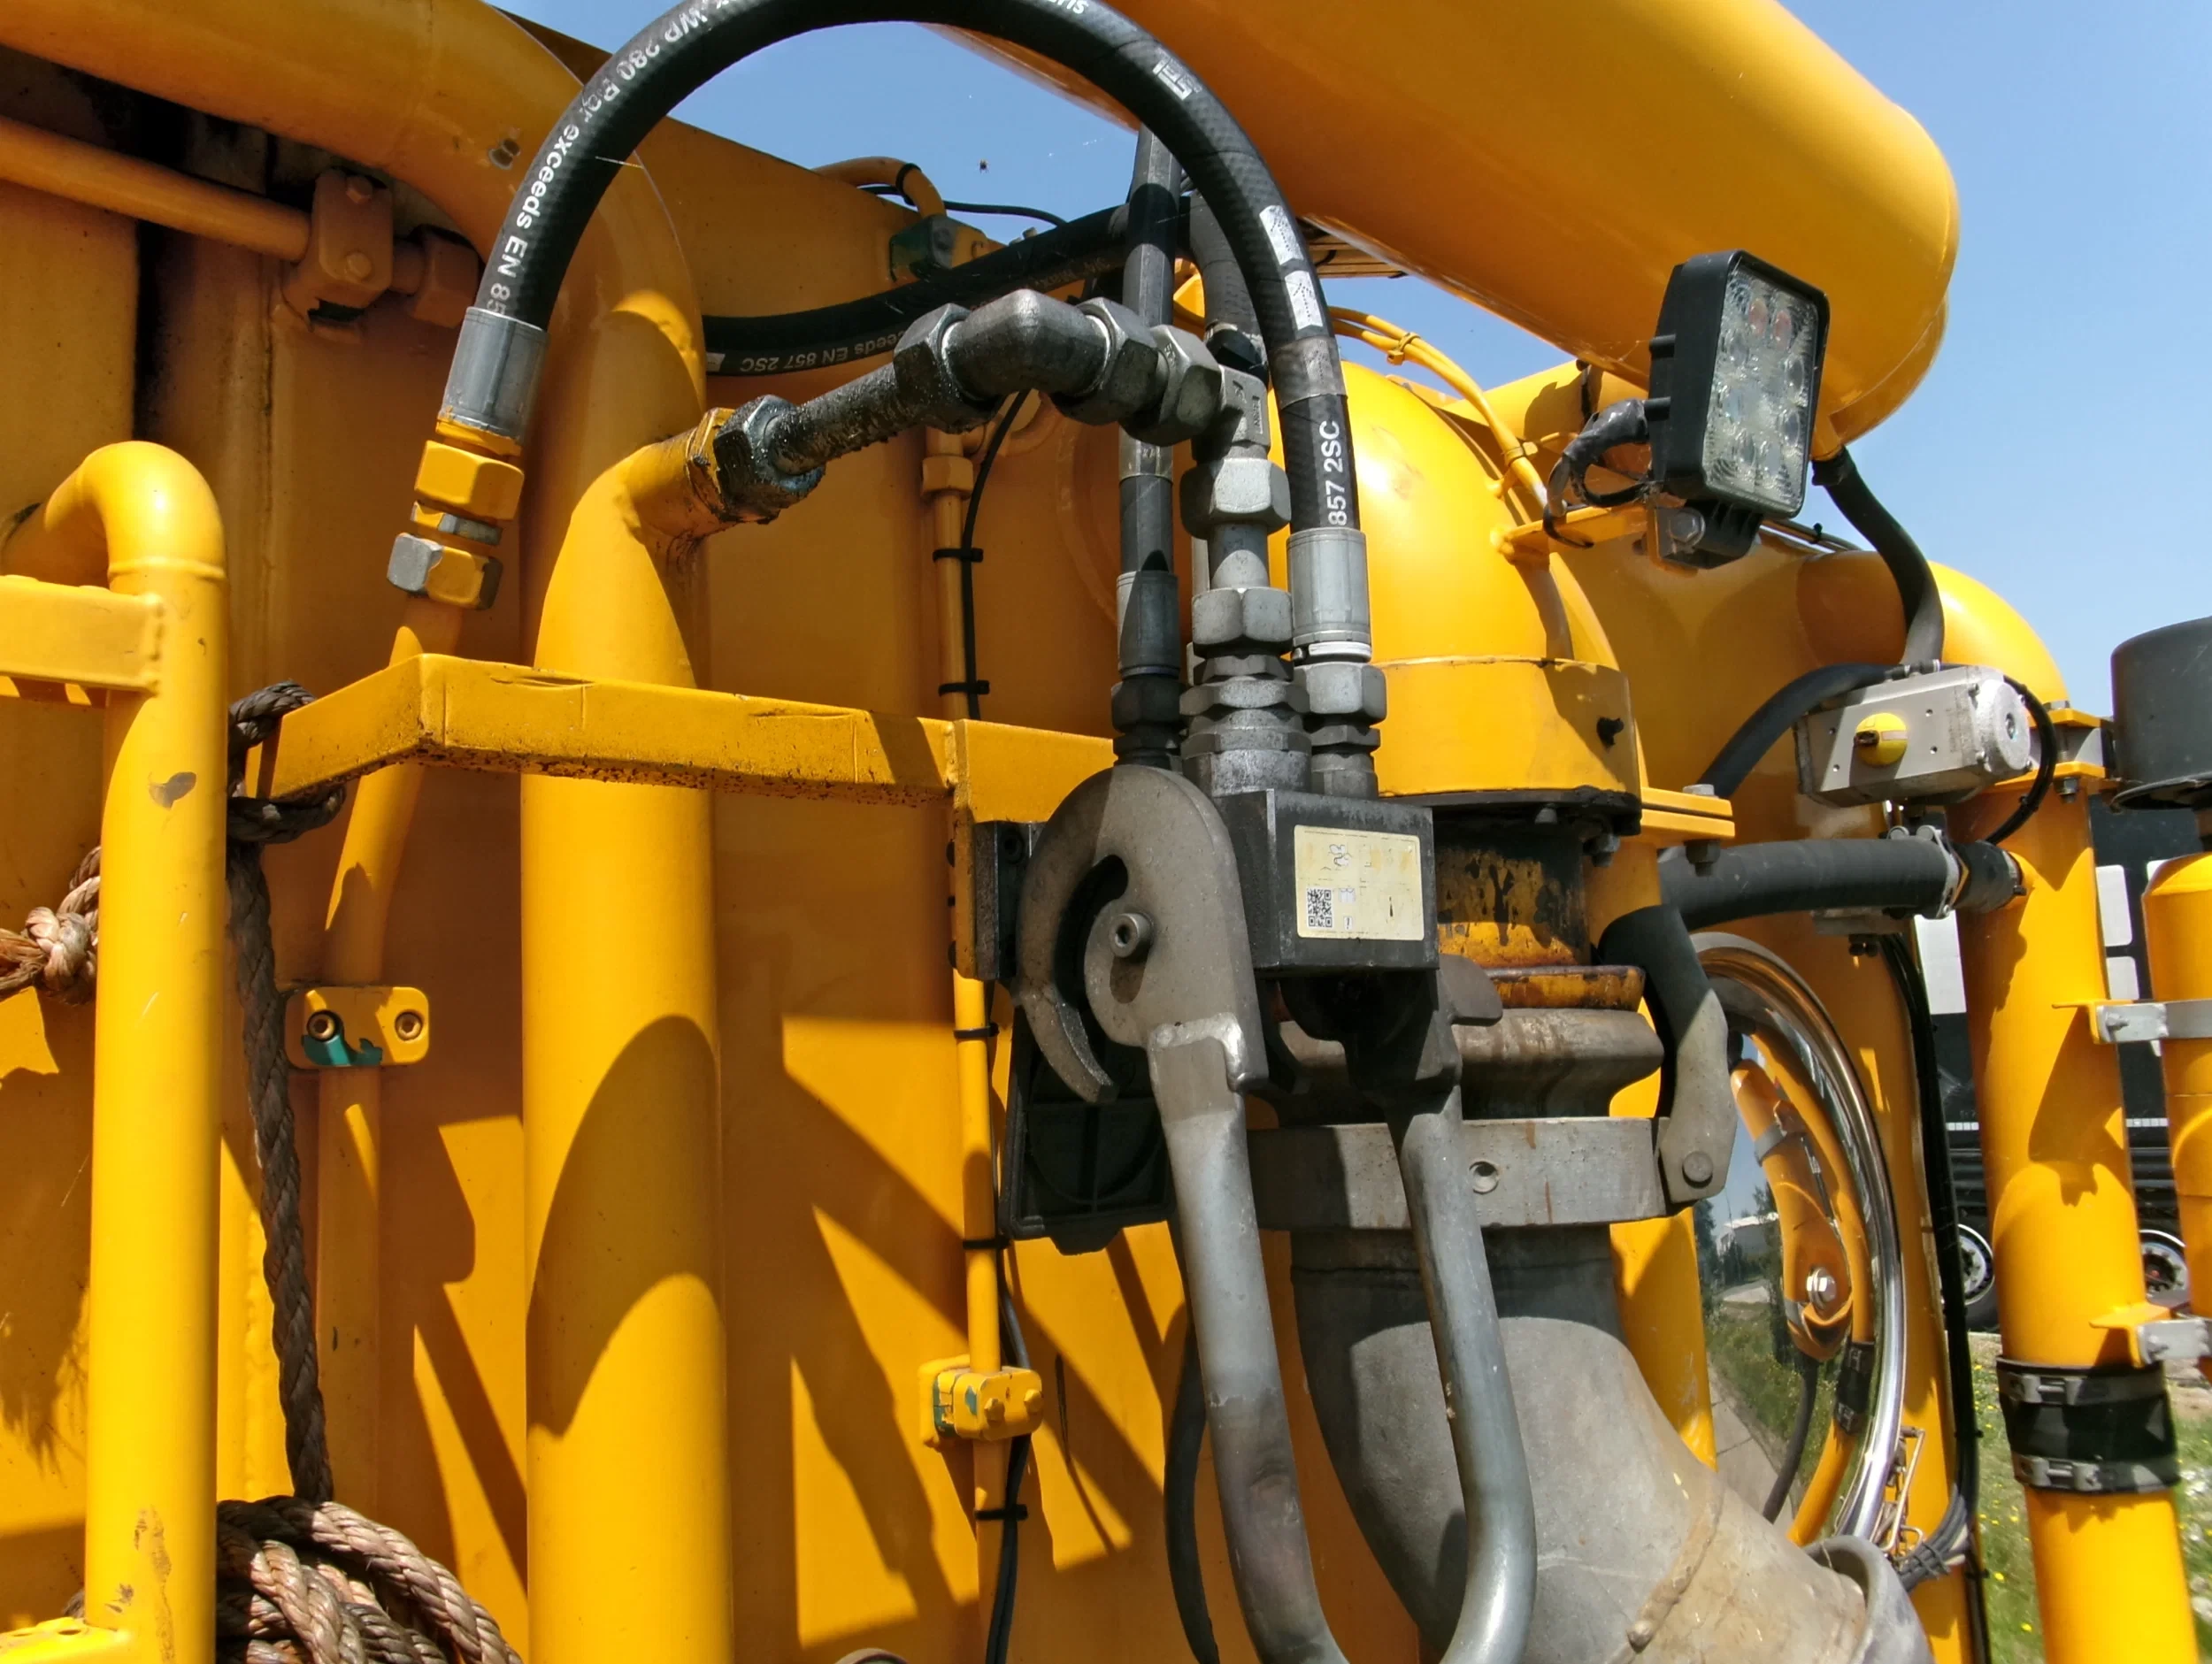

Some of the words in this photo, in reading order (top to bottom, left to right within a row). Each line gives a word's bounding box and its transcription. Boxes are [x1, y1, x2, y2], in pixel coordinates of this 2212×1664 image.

[664, 7, 708, 42] WP
[517, 124, 580, 229] exceeds
[497, 235, 529, 279] EN
[740, 357, 779, 372] 2SC
[783, 353, 816, 369] 857
[821, 346, 848, 364] EN
[1318, 420, 1344, 473] 2SC
[1325, 480, 1348, 526] 857
